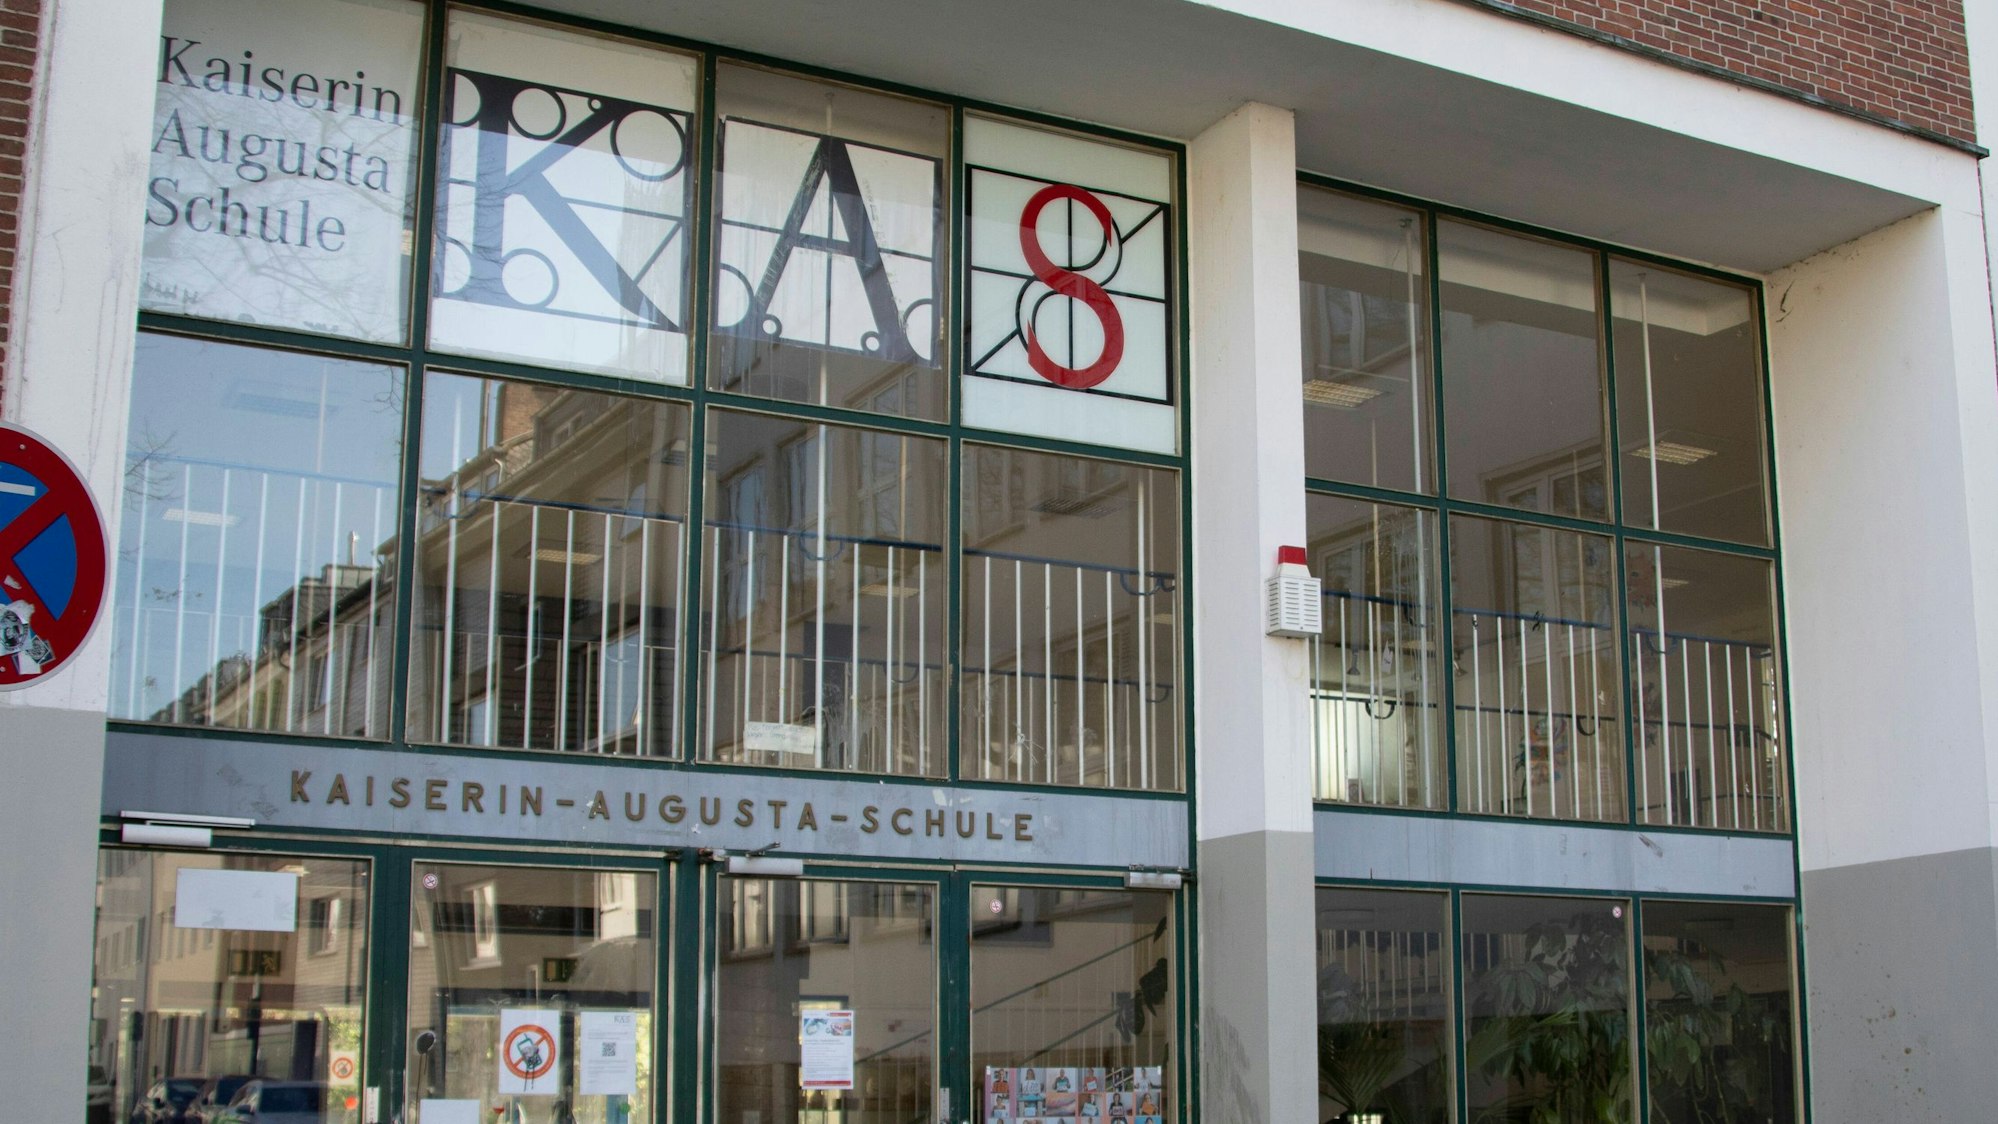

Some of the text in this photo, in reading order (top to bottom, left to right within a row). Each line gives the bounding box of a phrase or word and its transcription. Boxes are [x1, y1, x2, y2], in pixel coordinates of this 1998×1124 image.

[158, 35, 402, 127] Kaiserin
[151, 107, 391, 193] Augusta
[145, 176, 346, 253] Schule
